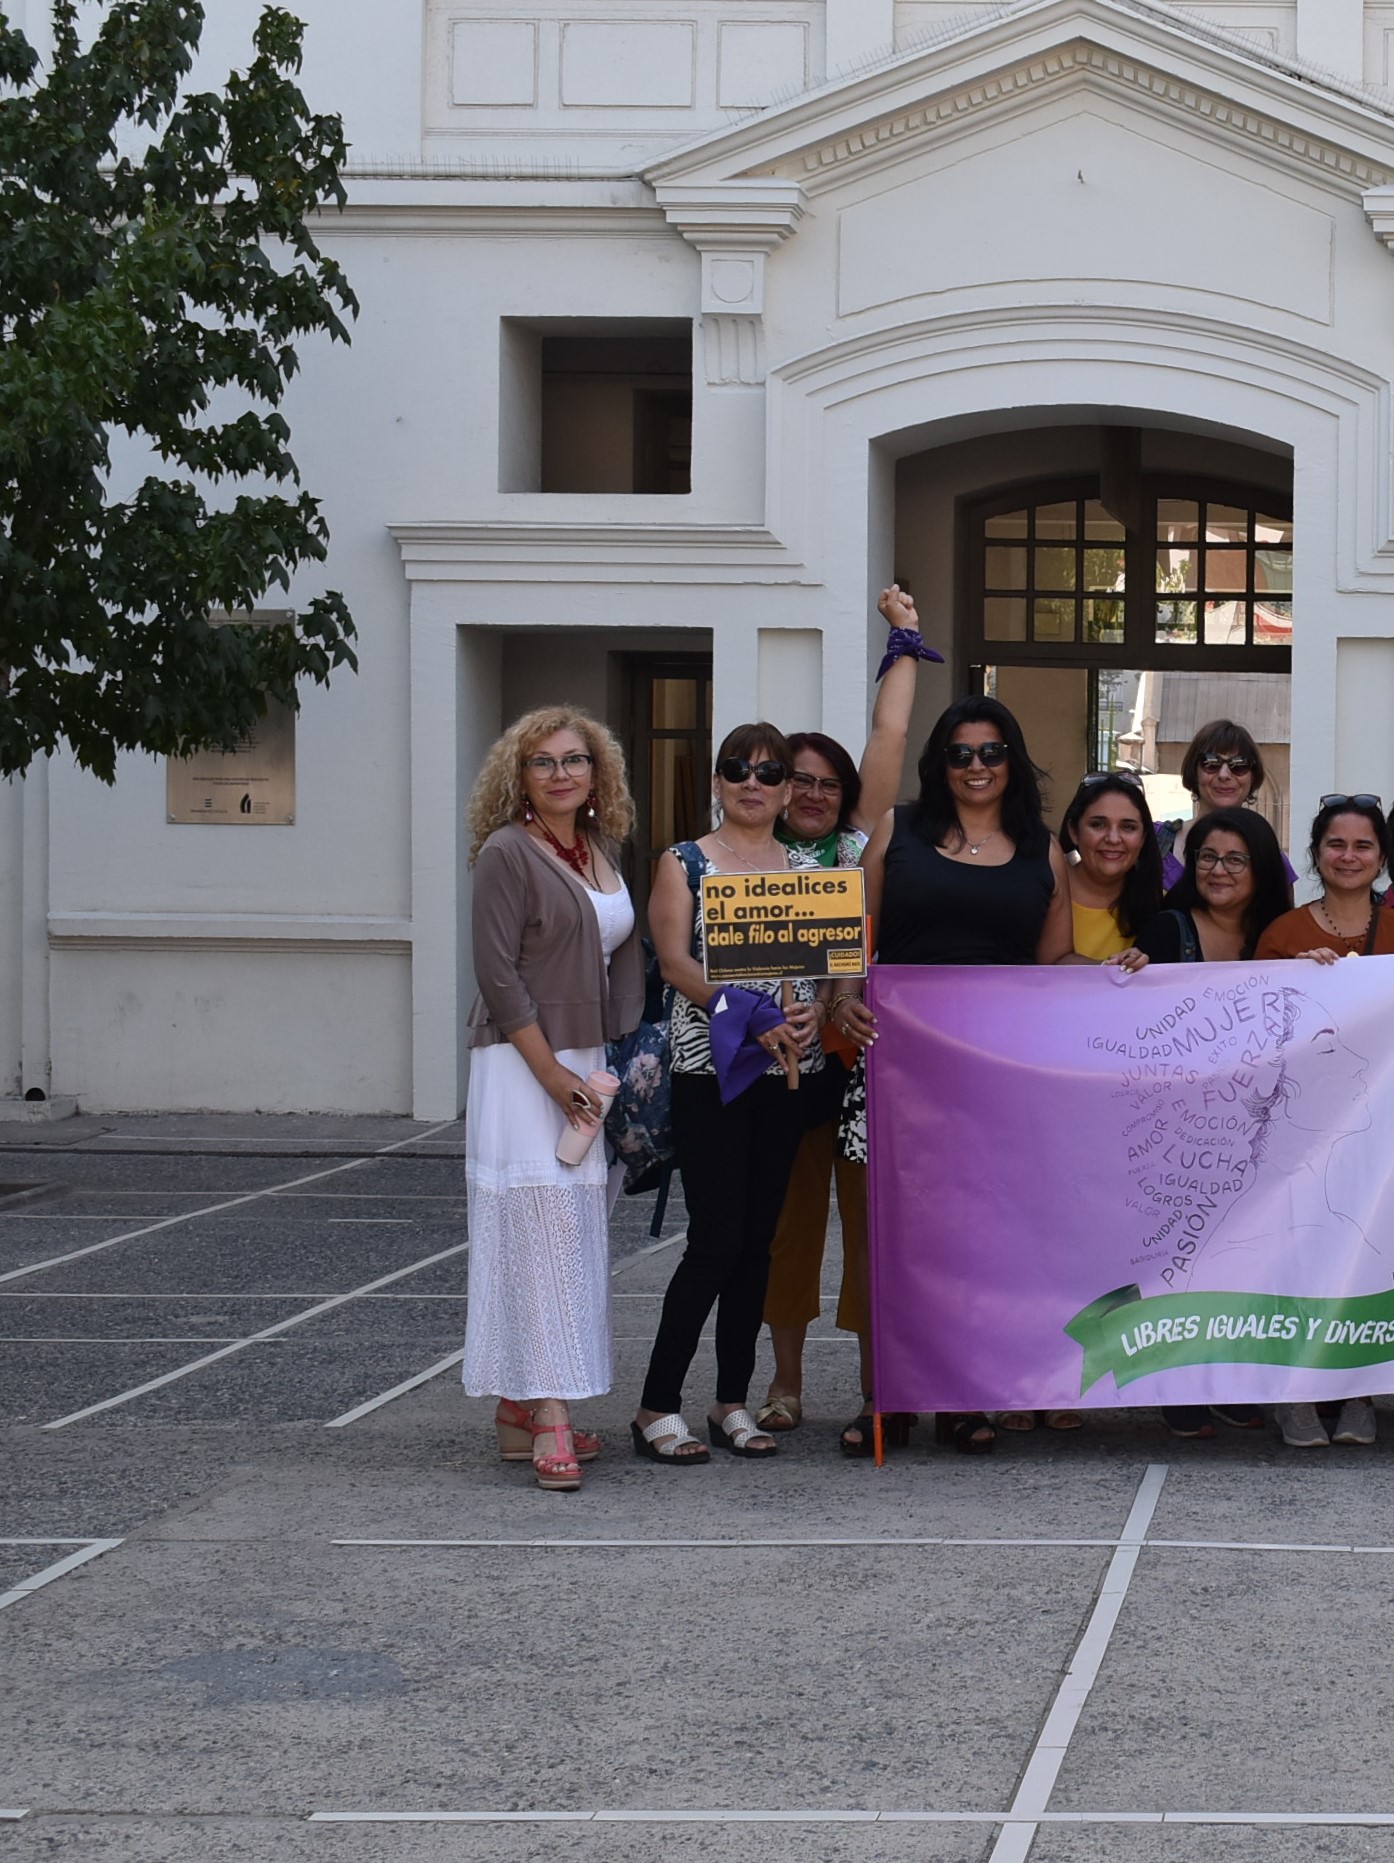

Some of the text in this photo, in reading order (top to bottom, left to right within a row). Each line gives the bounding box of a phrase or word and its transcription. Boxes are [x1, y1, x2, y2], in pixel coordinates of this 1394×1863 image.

[706, 875, 848, 899] no idealices
[706, 900, 815, 921] el amor...
[707, 922, 862, 947] dale filo al agresor
[1203, 975, 1270, 1002] EMOCIÓN
[1136, 997, 1196, 1041] UNIDAD
[1172, 991, 1281, 1058] MUJER
[1087, 1036, 1173, 1060] IGUALDAD
[1121, 1063, 1200, 1088] JUNTAS
[1130, 1081, 1173, 1111] VALOR
[1171, 1099, 1254, 1137] EMOCIÓN
[1127, 1118, 1169, 1162] AMOR
[1174, 1126, 1235, 1147] DEDICACIÓN
[1162, 1143, 1249, 1178] LUCHA
[1138, 1177, 1193, 1208] LOGROS
[1160, 1173, 1243, 1195] IGUALDAD
[1125, 1198, 1160, 1218] VALOR
[1143, 1209, 1183, 1248] UNIDAD
[1160, 1195, 1218, 1288] PASIÓN
[1121, 1315, 1200, 1357] LIBRES
[1206, 1313, 1299, 1341] IGUALES
[1306, 1317, 1320, 1341] Y
